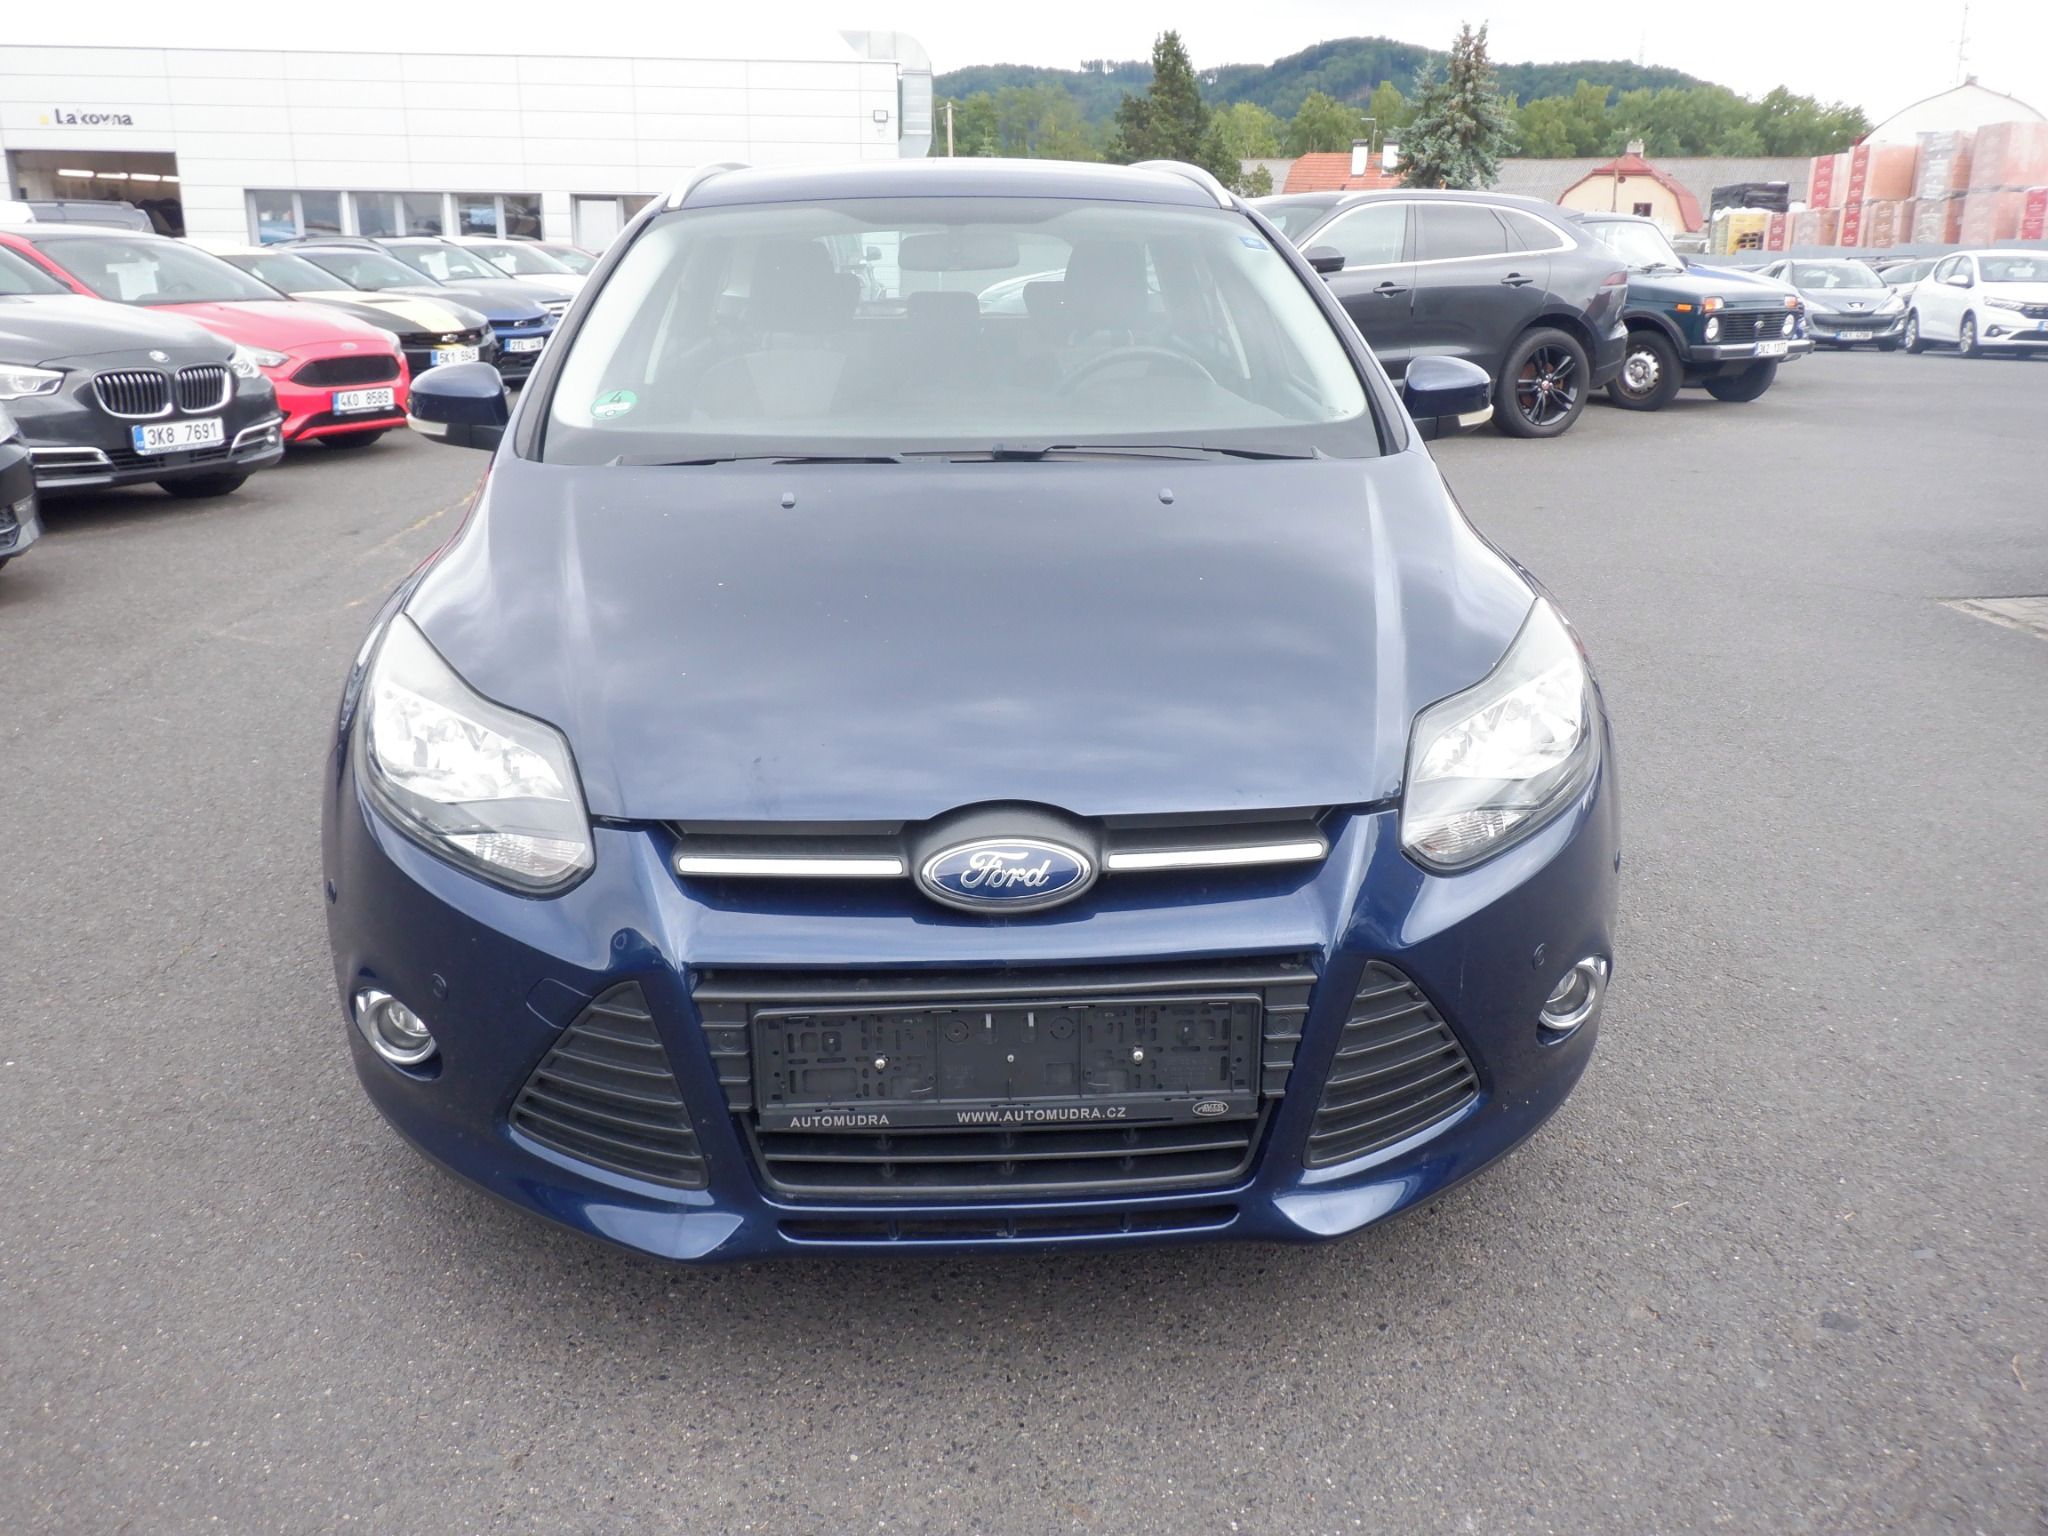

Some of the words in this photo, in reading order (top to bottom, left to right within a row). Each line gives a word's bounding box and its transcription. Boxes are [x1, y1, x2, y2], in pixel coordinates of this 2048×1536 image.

[609, 391, 622, 404] 4
[147, 427, 175, 446] 3K8
[184, 422, 218, 442] 7691
[960, 850, 1052, 889] Ford
[790, 1114, 889, 1128] AUTOMUDRA
[957, 1107, 1126, 1123] WWW.AUTOMUDRA.CZ
